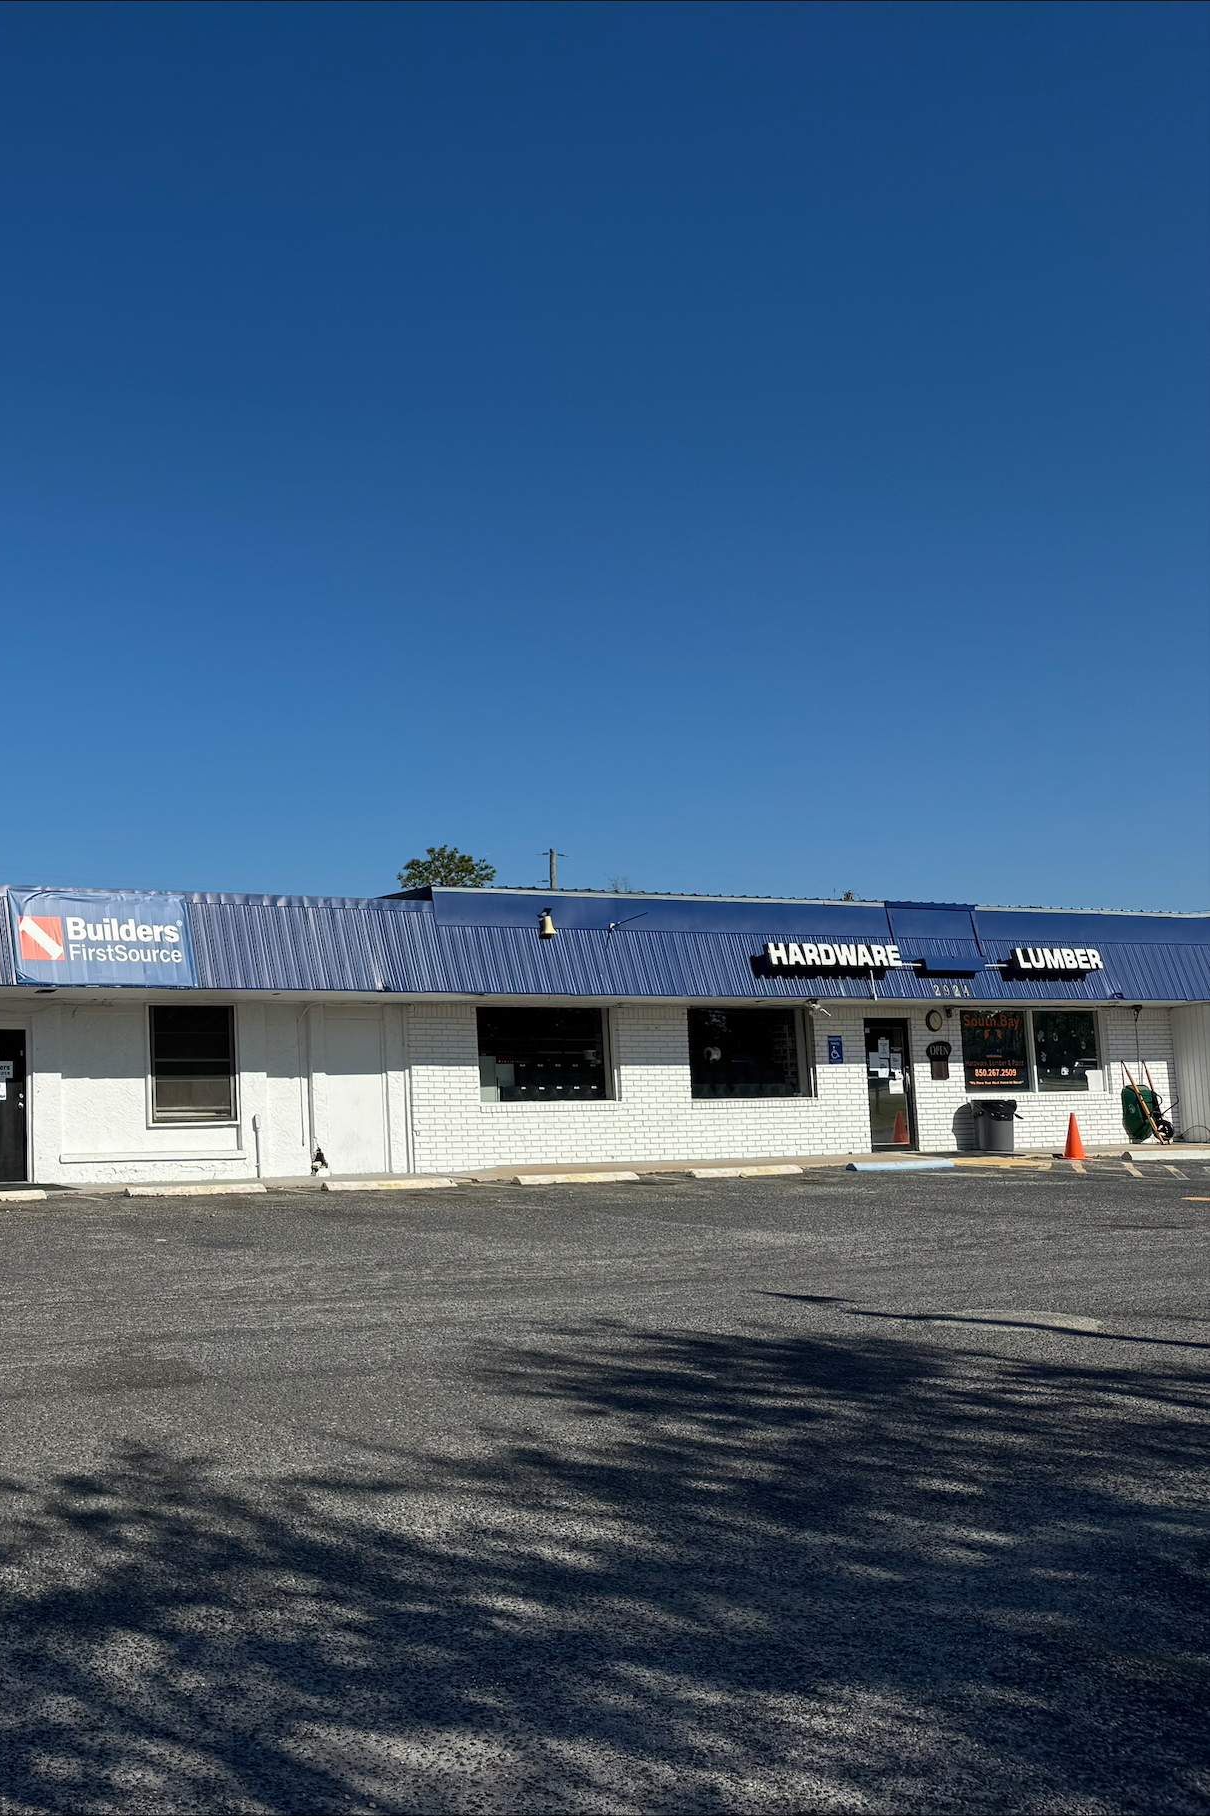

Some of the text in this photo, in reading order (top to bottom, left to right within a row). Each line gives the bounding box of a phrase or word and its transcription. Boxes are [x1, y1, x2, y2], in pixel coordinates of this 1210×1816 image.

[65, 917, 181, 943] Builders
[69, 943, 183, 963] FirstSource
[767, 942, 903, 967] HARDWARE
[1015, 947, 1104, 969] LUMBER
[933, 984, 970, 998] 2924
[963, 1014, 1020, 1030] South Bay
[930, 1045, 949, 1056] OPEN
[974, 1068, 1017, 1077] 850.267.2509
